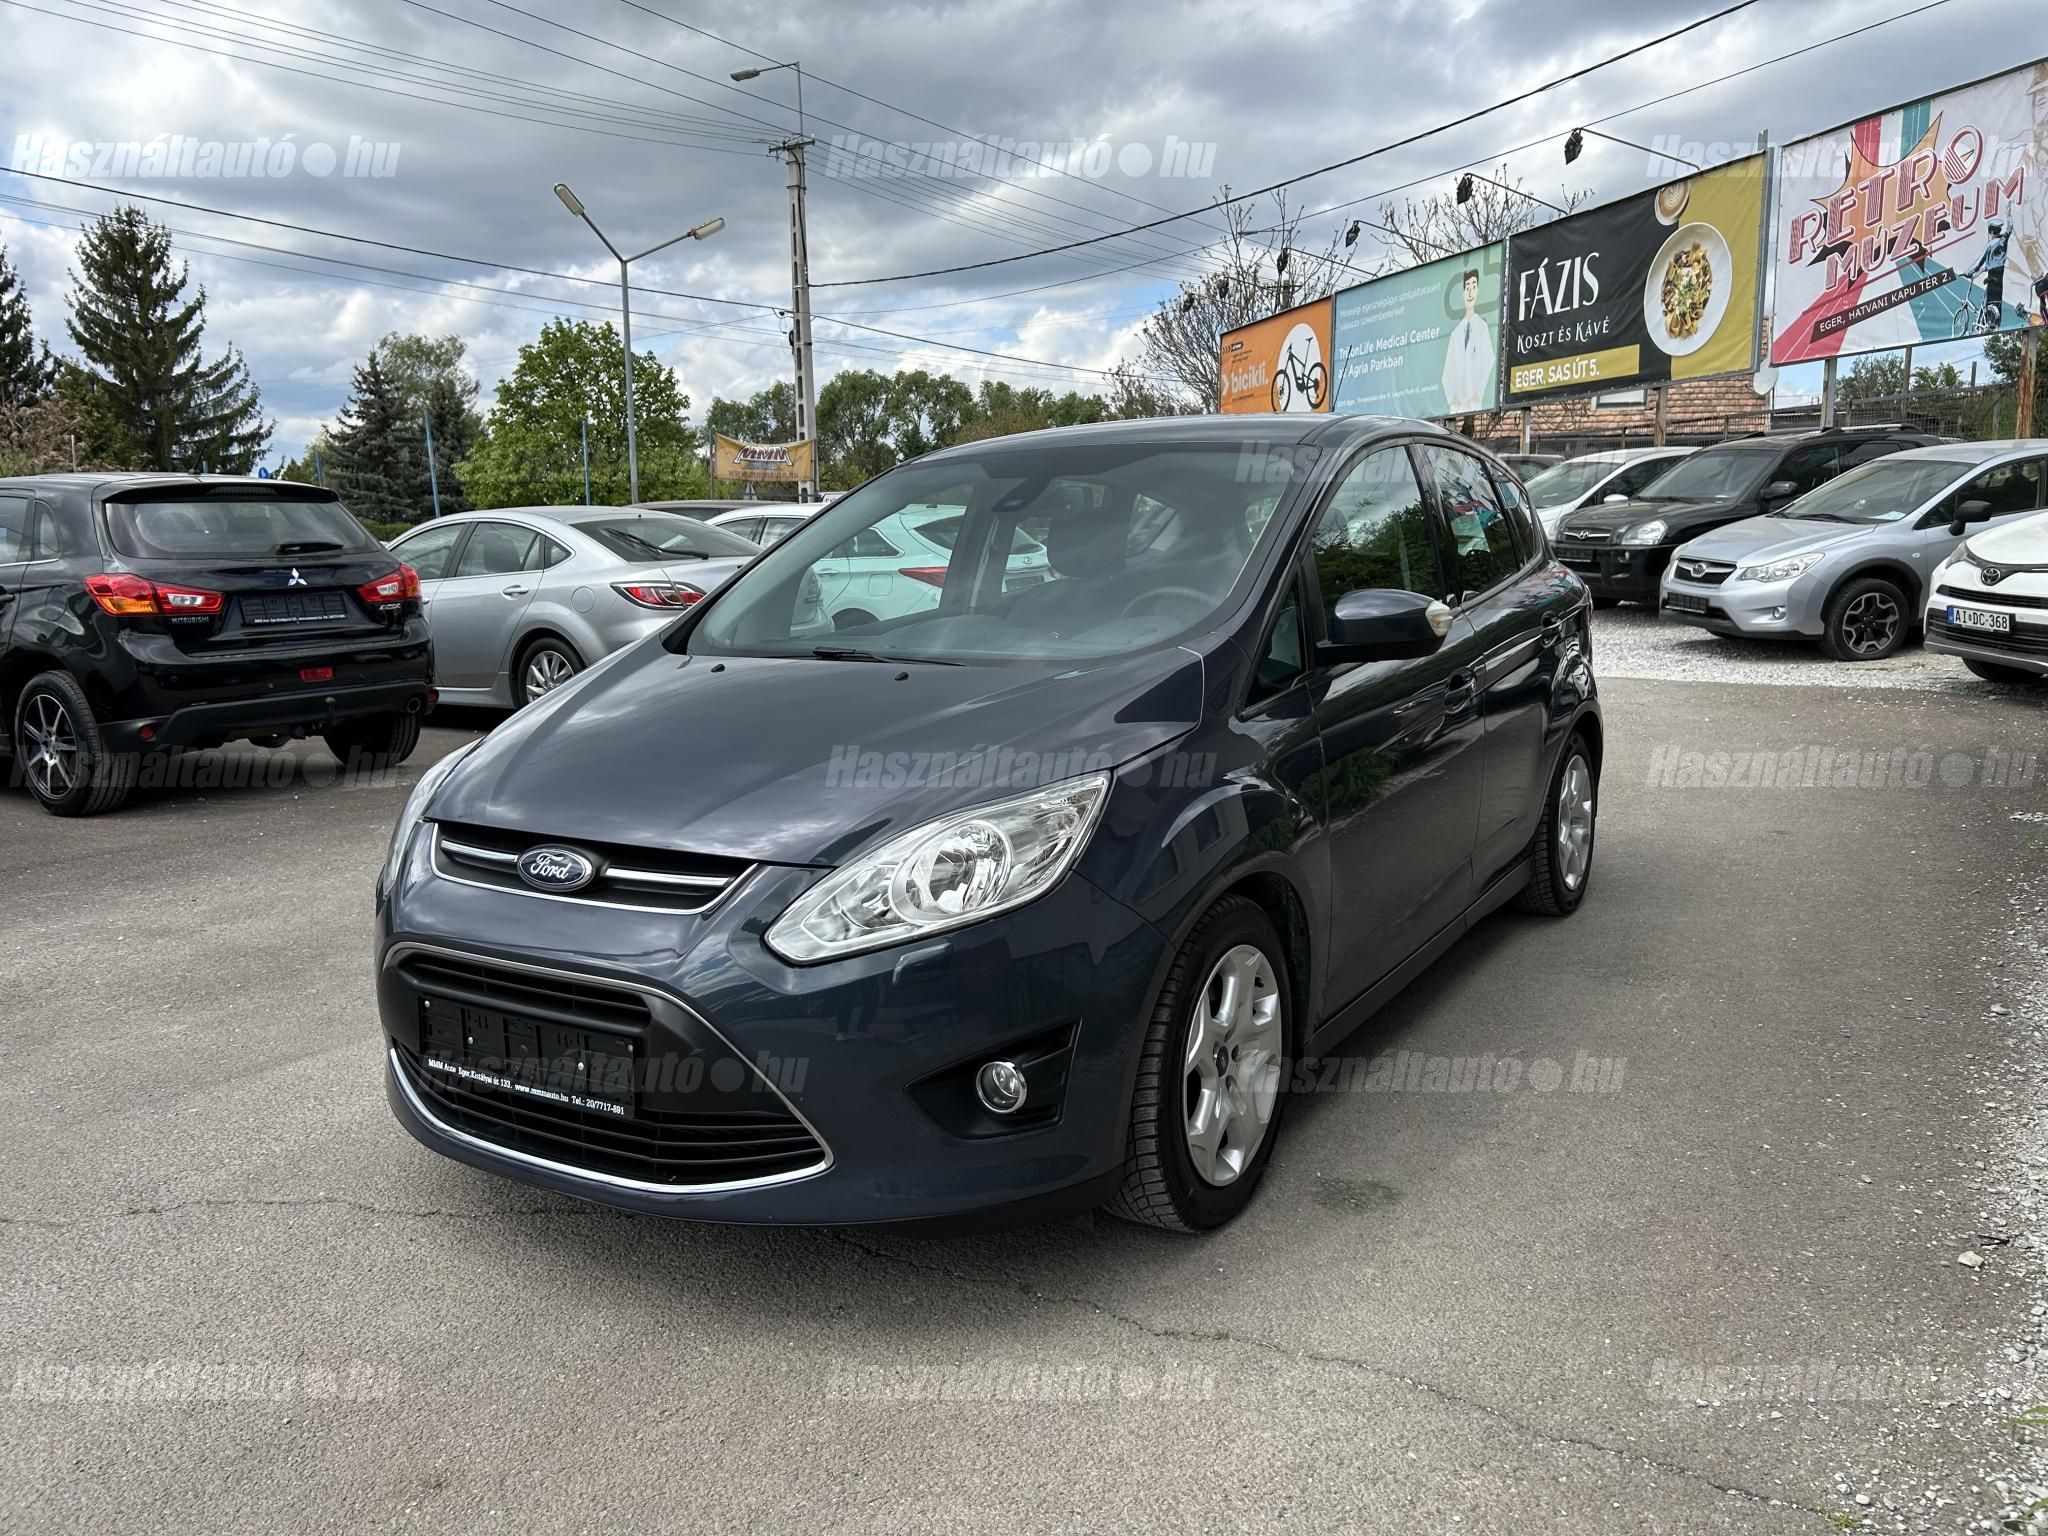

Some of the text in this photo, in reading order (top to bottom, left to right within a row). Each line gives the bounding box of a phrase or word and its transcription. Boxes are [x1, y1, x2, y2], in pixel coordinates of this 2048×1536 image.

[1788, 124, 1983, 265] RETRO
[1825, 166, 2025, 291] MÚZEUM
[1518, 252, 1600, 322] FÁZIS
[1818, 273, 1953, 333] EGER, HATVANI KAPU TÉR 2.
[1376, 332, 1408, 351] Medical
[1410, 327, 1440, 344] Center
[1348, 362, 1369, 378] Agria
[1370, 355, 1404, 372] Parkban
[1515, 358, 1600, 389] EGER, SAS ÚT 5.
[530, 853, 572, 880] Ford
[428, 1059, 443, 1070] MMM
[500, 1078, 513, 1090] 133.
